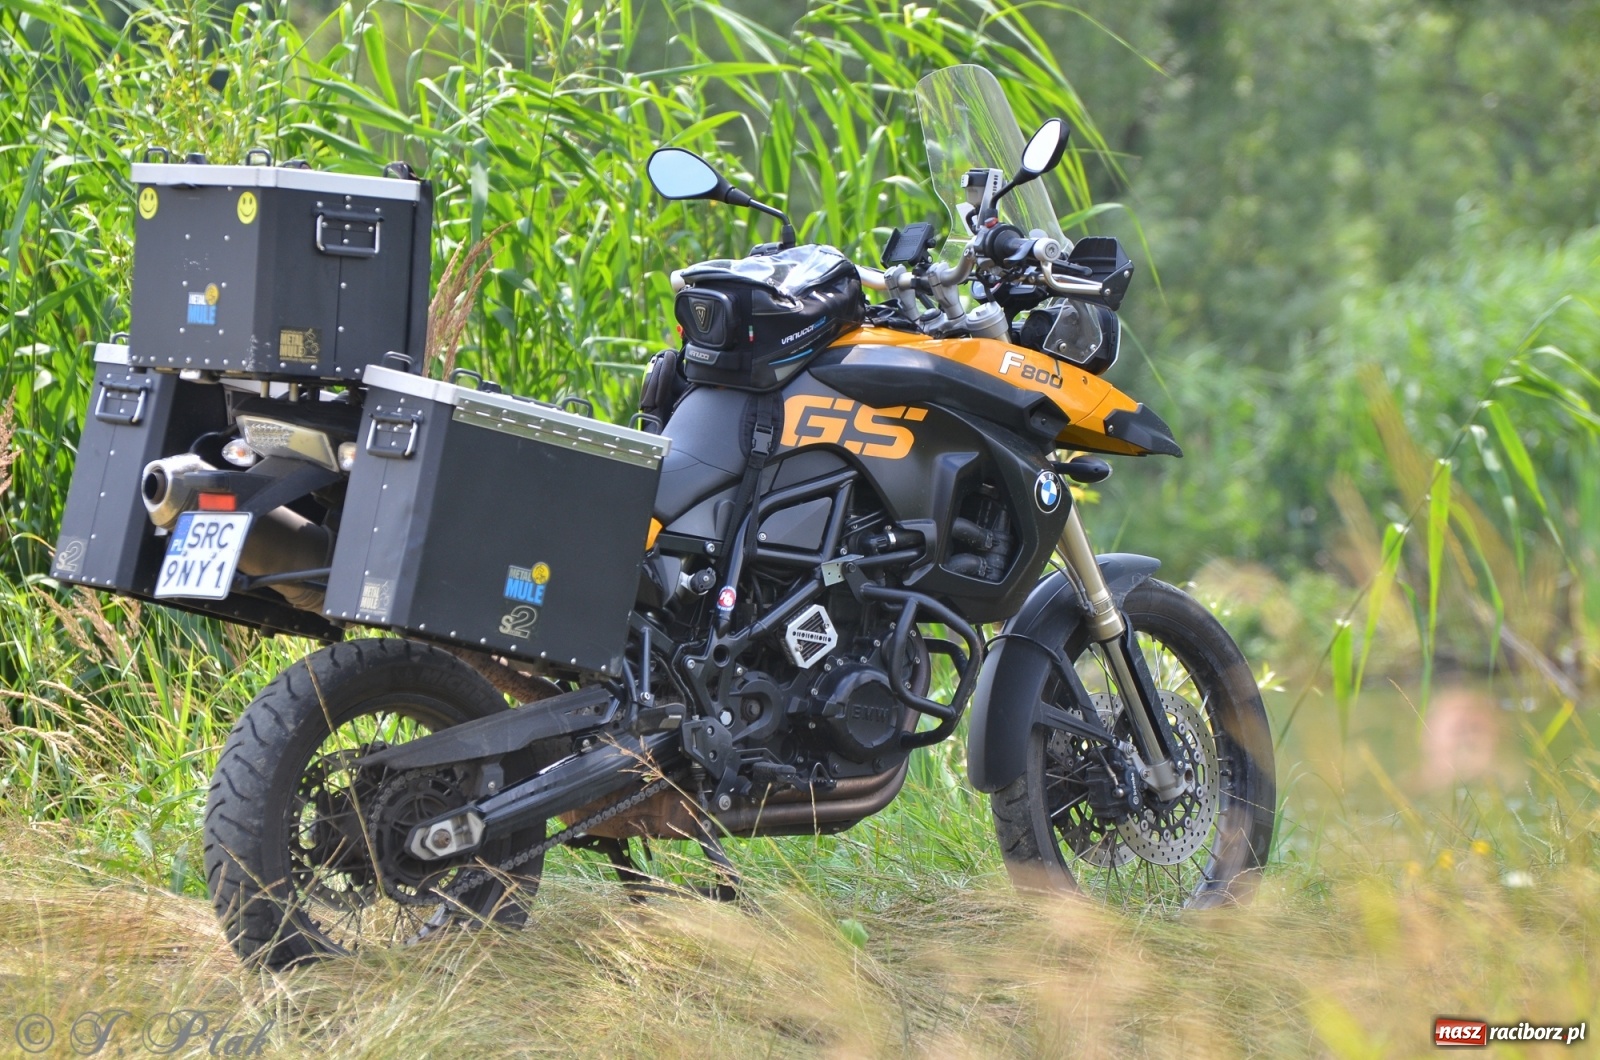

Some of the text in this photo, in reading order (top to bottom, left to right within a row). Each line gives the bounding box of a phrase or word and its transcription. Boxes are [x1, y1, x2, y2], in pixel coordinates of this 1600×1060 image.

[187, 304, 217, 325] MULE
[781, 324, 815, 345] VANUCCI
[280, 345, 305, 358] MULE
[688, 349, 710, 361] VANUCCI
[780, 394, 929, 460] GS
[170, 538, 184, 552] PL
[187, 521, 234, 549] SRC
[162, 559, 226, 589] 9NY1
[509, 567, 533, 582] METAL
[504, 578, 545, 605] MULE
